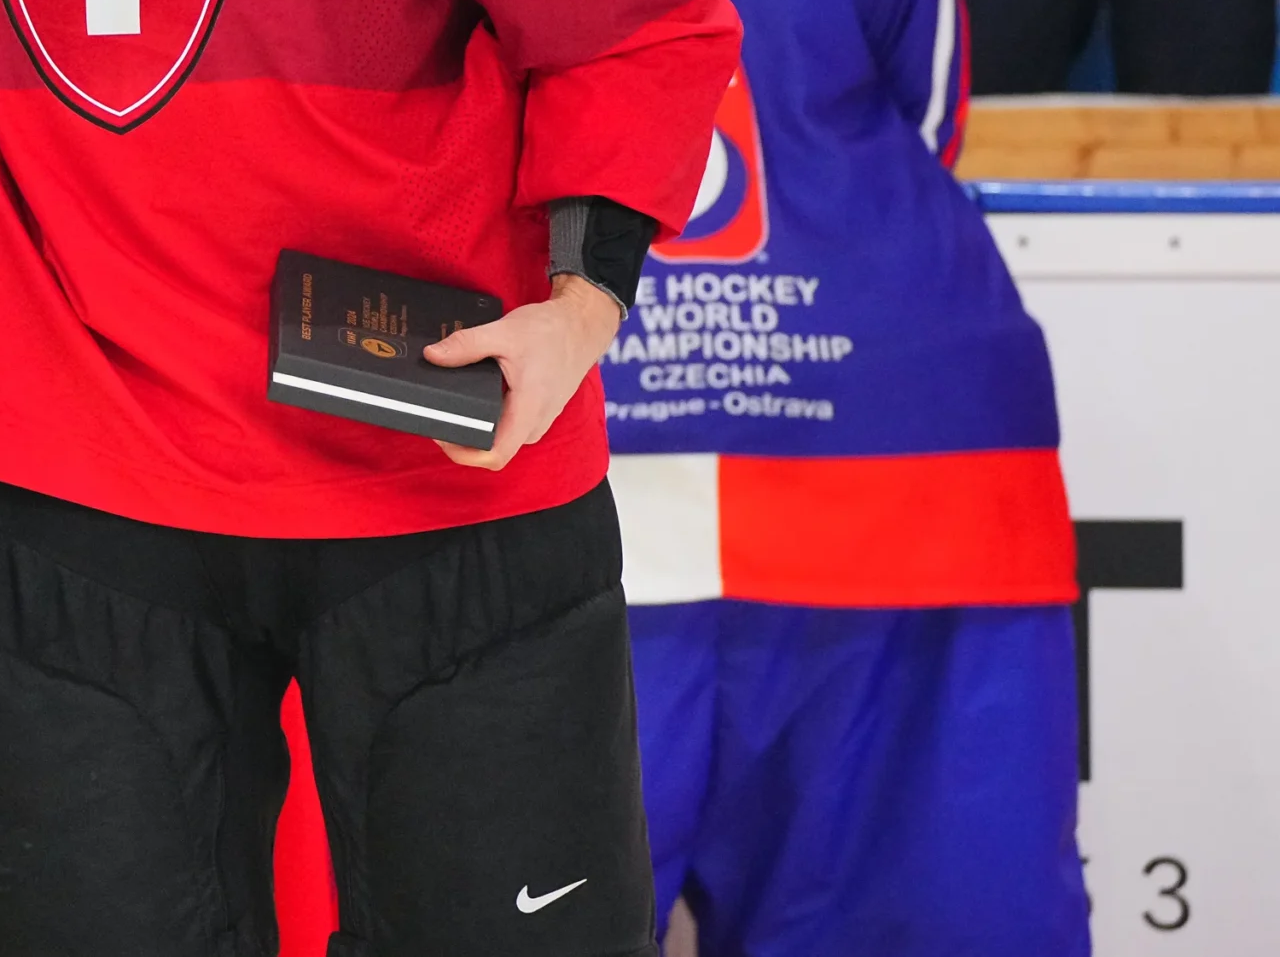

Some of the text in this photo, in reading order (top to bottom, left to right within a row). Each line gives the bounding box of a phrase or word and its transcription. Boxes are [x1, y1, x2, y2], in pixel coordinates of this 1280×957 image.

[665, 272, 820, 306] HOCKEY
[301, 273, 313, 341] BEST PLAYER AWARD
[639, 301, 778, 334] WORLD
[598, 331, 853, 365] HAMPIONSHIP
[639, 362, 791, 392] CZECHIA
[605, 397, 706, 422] Prague
[722, 390, 835, 422] Ostrava
